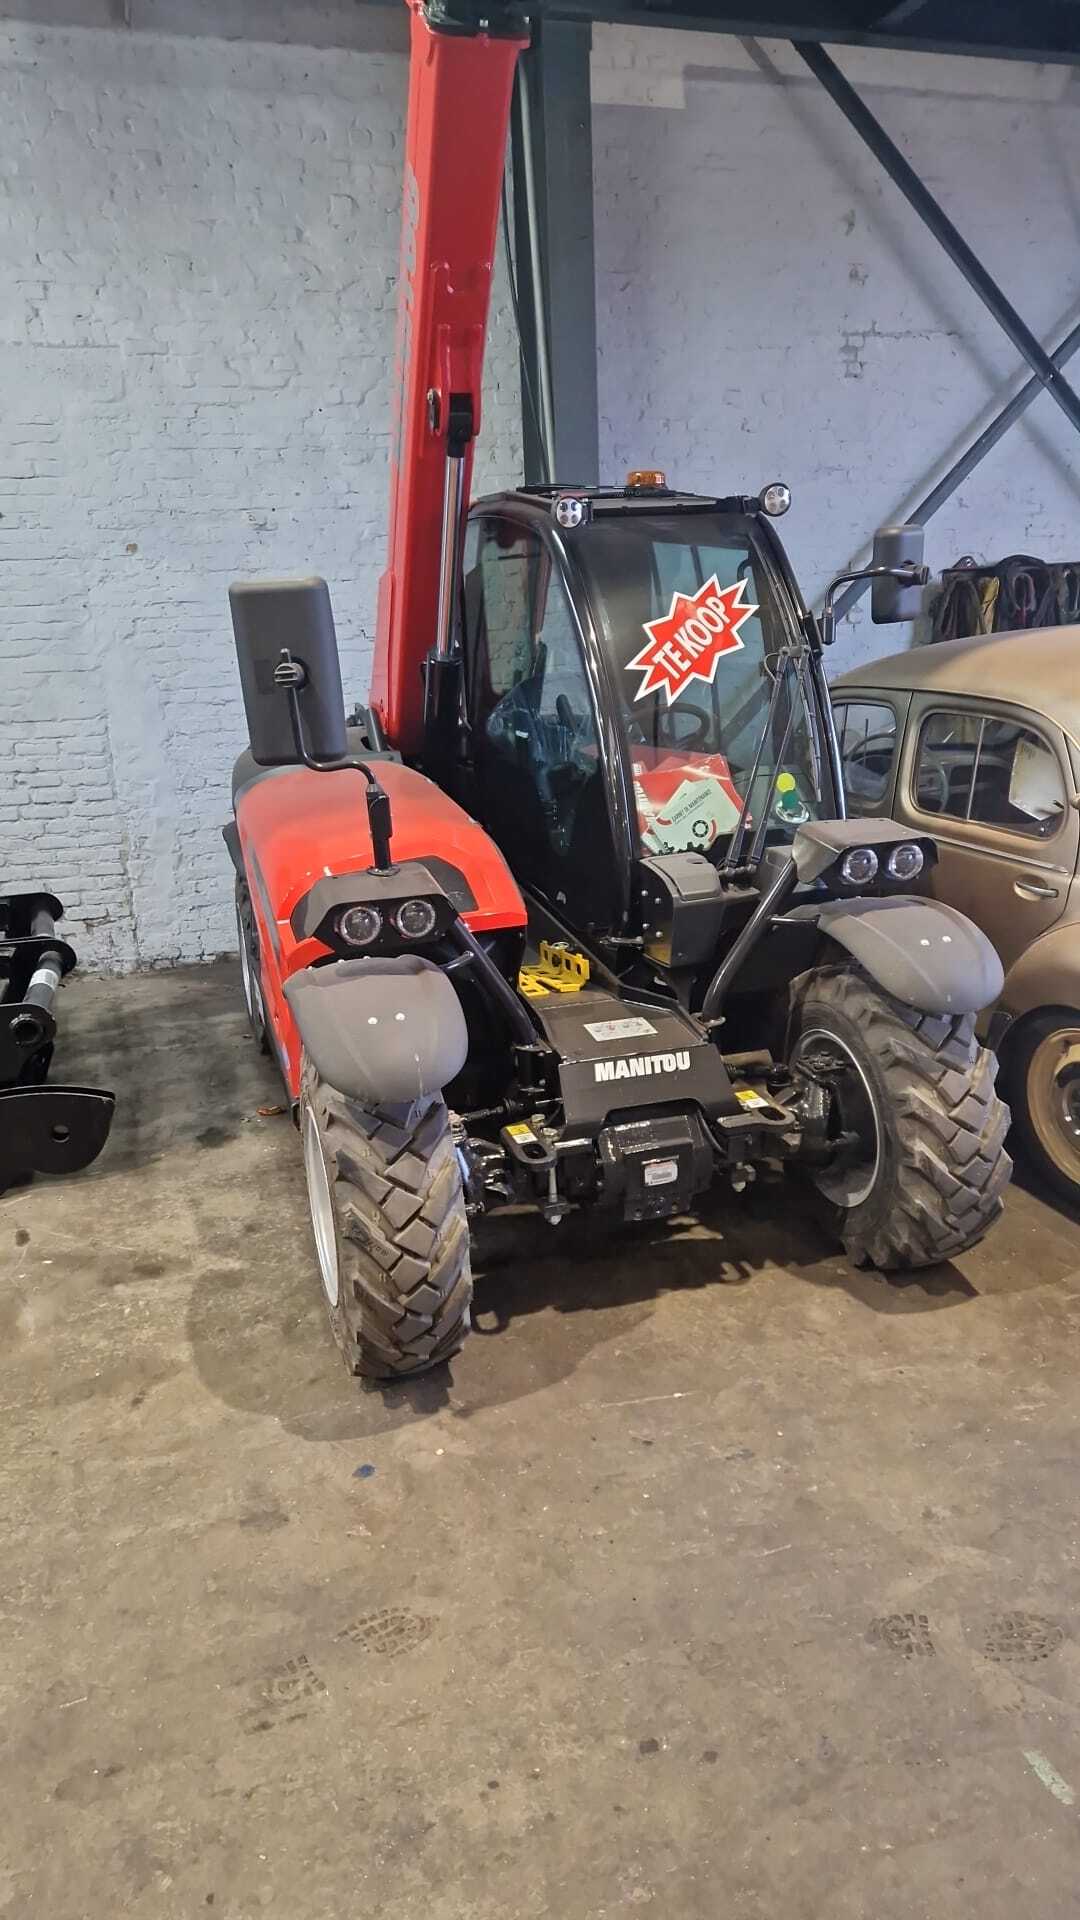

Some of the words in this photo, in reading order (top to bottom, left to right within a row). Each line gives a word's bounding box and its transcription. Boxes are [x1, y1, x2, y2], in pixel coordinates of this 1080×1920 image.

[651, 641, 692, 679] TE
[673, 596, 731, 659] KOOP
[594, 1051, 691, 1082] MANITOU
